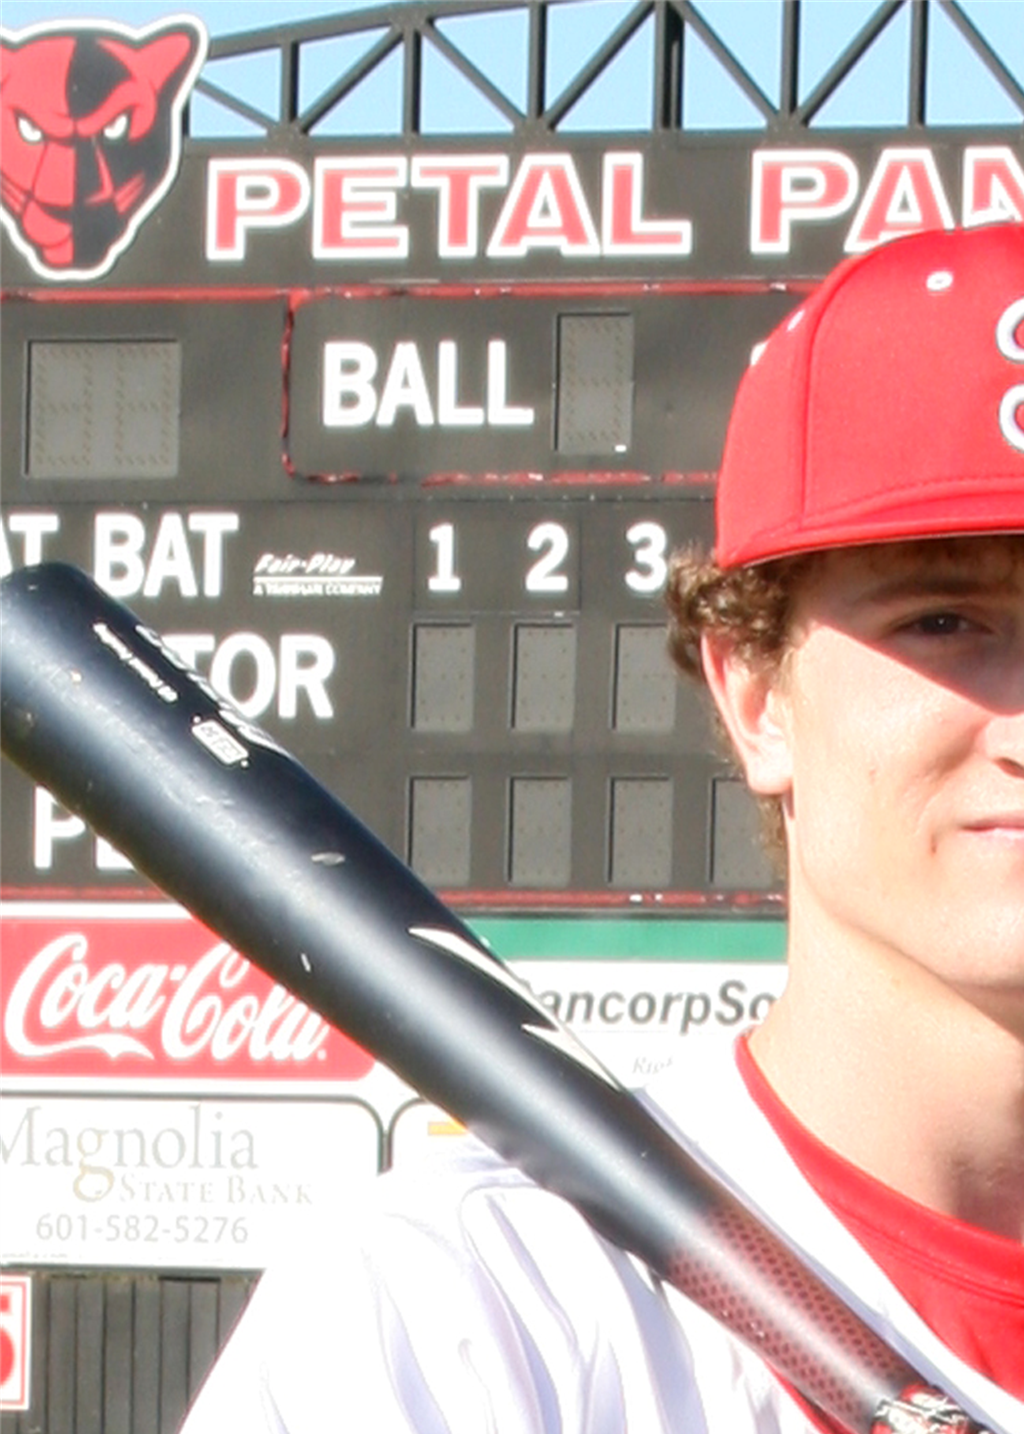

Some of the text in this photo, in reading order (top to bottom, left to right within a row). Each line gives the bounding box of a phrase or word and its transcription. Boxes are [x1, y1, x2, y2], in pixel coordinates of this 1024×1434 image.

[206, 151, 693, 261] PETAL
[322, 340, 535, 428] BALL
[94, 512, 239, 599] BAT
[428, 523, 461, 592] 1
[526, 522, 569, 592] 2
[625, 521, 668, 593] 3
[518, 978, 779, 1036] ancorpSo
[120, 1174, 313, 1206] STATE BANK
[35, 1213, 250, 1245] 601-582-5276
